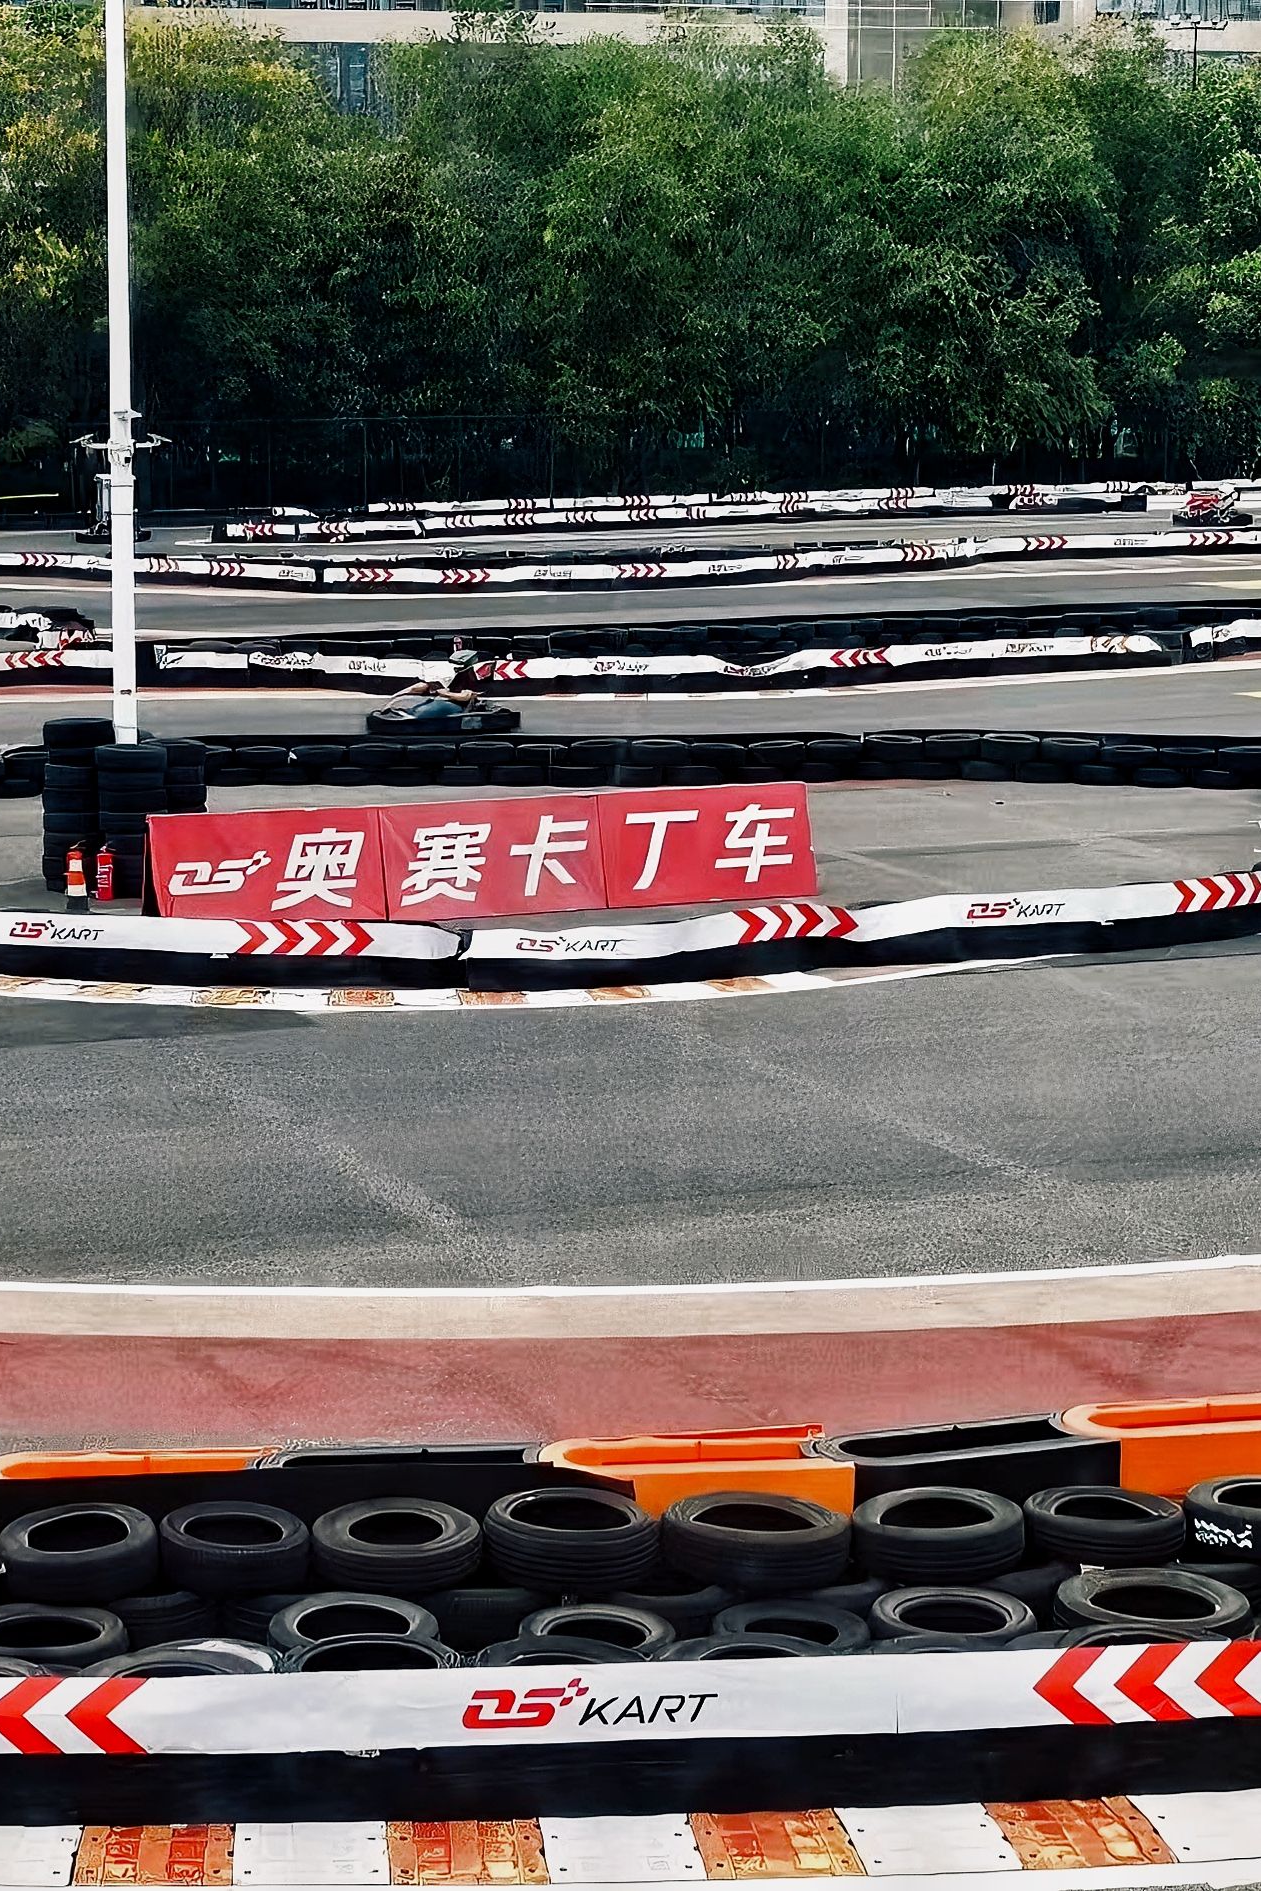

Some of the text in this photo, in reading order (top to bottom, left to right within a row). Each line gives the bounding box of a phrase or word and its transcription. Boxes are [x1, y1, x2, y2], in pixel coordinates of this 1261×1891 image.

[270, 803, 796, 912] 奥赛卡丁车
[50, 926, 105, 941] KART
[565, 939, 623, 952] KART
[578, 1693, 719, 1726] KART
